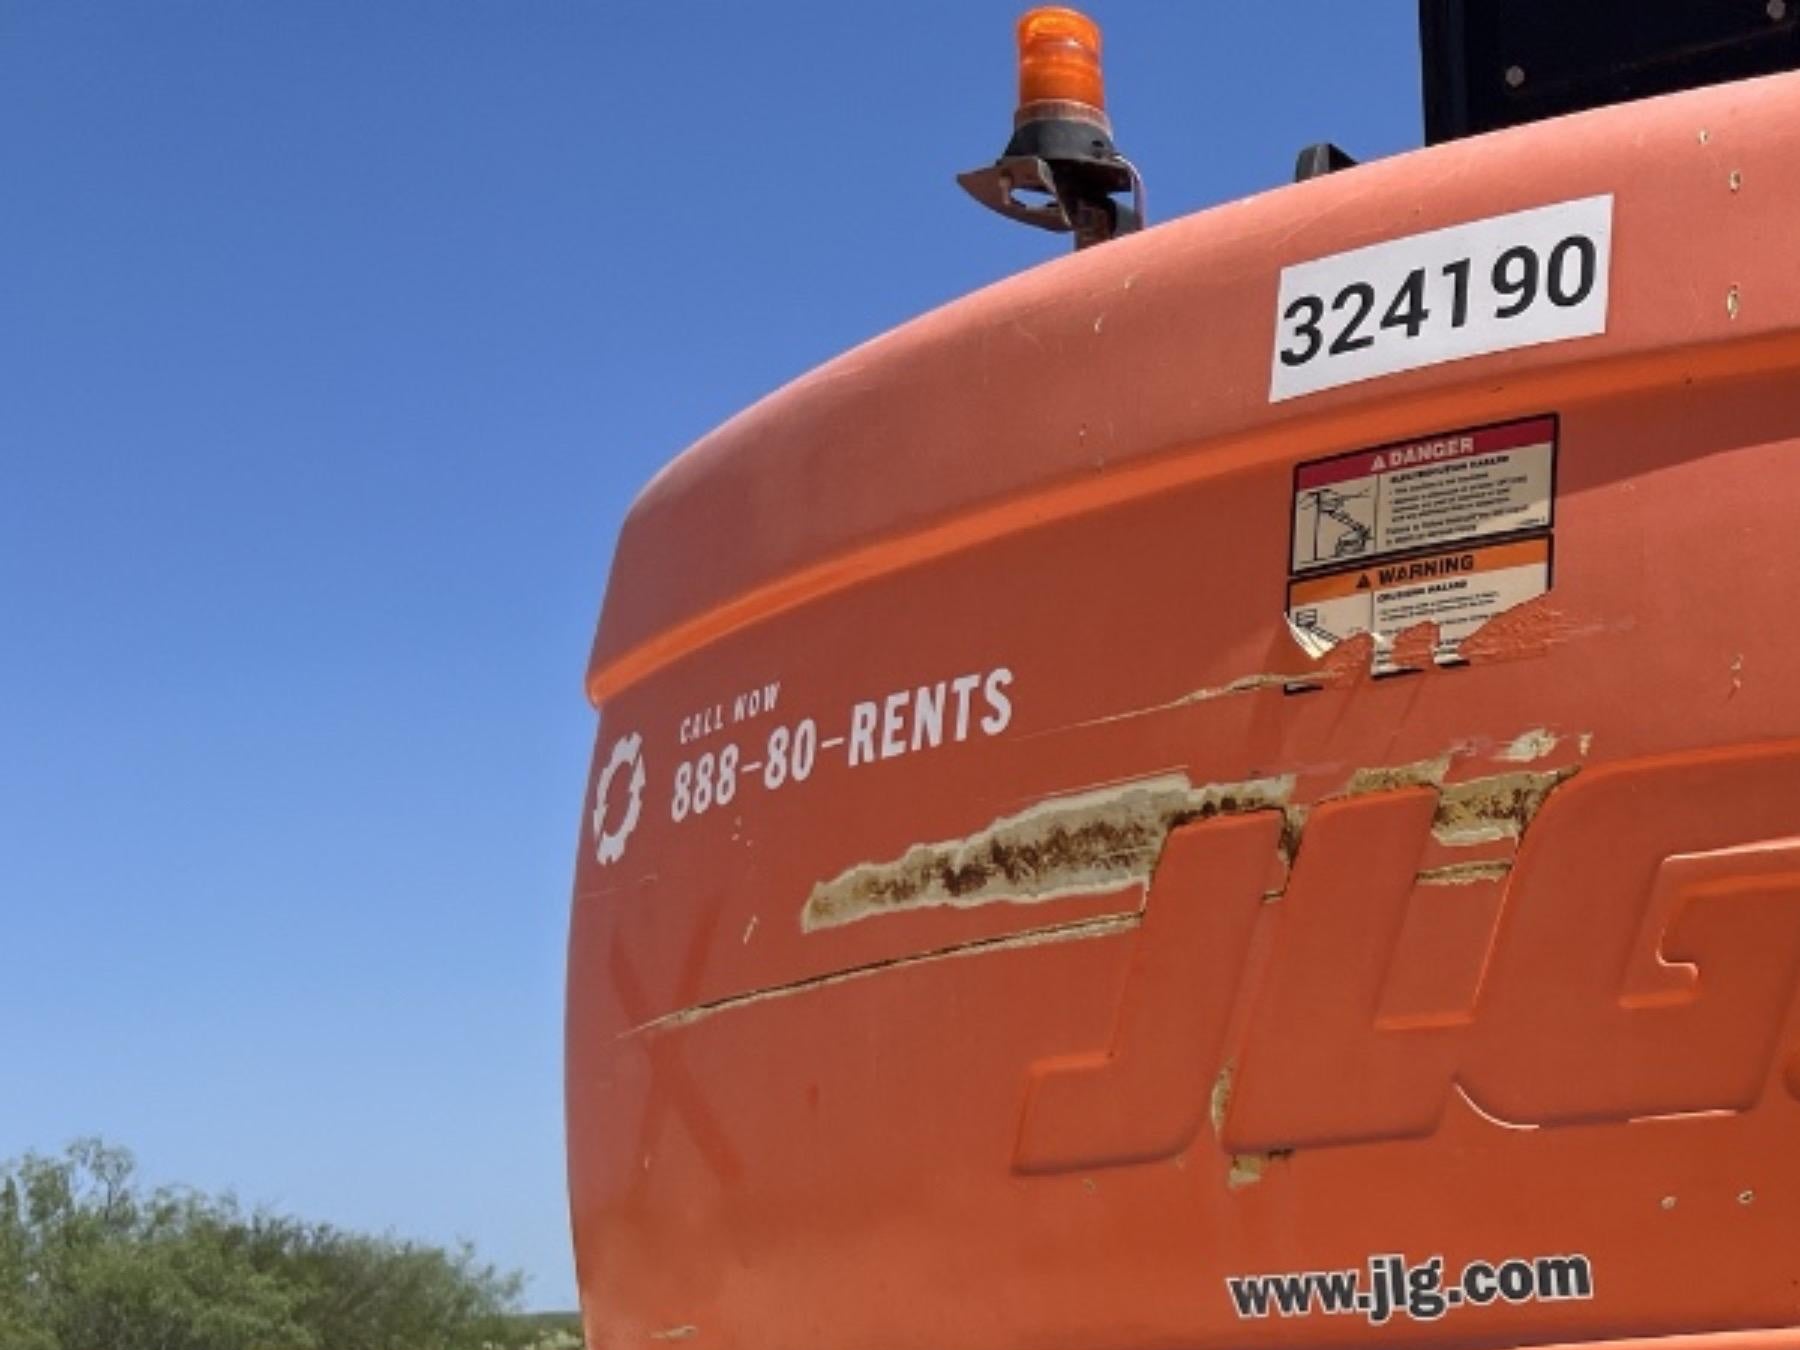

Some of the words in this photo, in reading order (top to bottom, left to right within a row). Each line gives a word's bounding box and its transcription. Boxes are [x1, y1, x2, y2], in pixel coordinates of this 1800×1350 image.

[1280, 233, 1597, 367] 324190
[1389, 437, 1475, 466] DANGER
[1378, 555, 1474, 585] WARNING
[671, 668, 1013, 823] 888-80-RENTS
[680, 703, 724, 745] CALL
[734, 681, 781, 723] NOW
[1226, 1253, 1593, 1325] www.jlg.com
